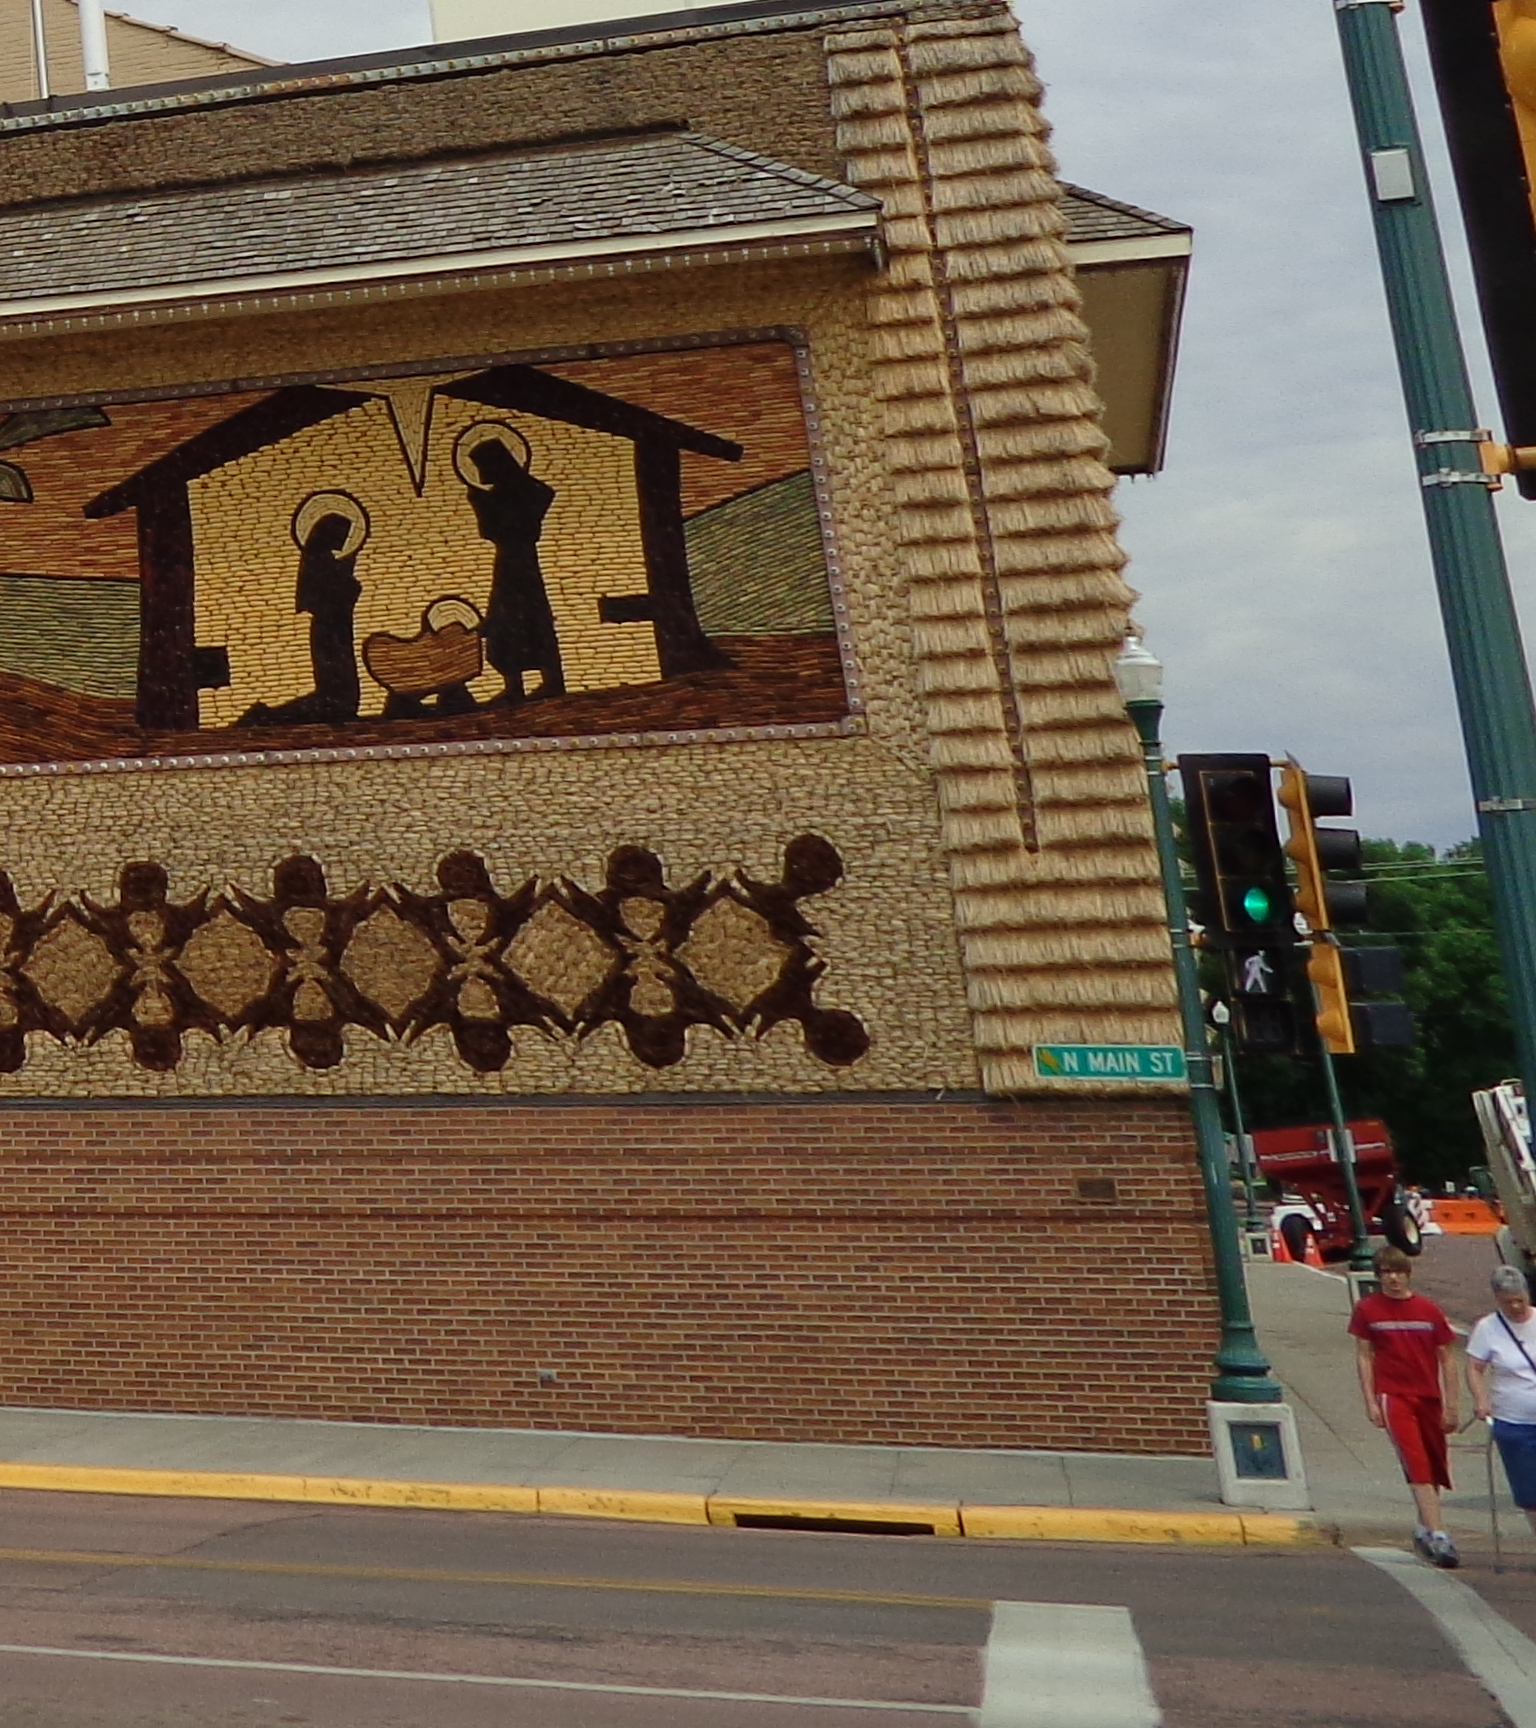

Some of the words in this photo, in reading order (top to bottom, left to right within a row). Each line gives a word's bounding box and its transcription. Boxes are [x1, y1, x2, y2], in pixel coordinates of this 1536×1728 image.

[1063, 1052, 1078, 1072] N
[1087, 1051, 1141, 1073] MAIN
[1150, 1052, 1174, 1073] ST
